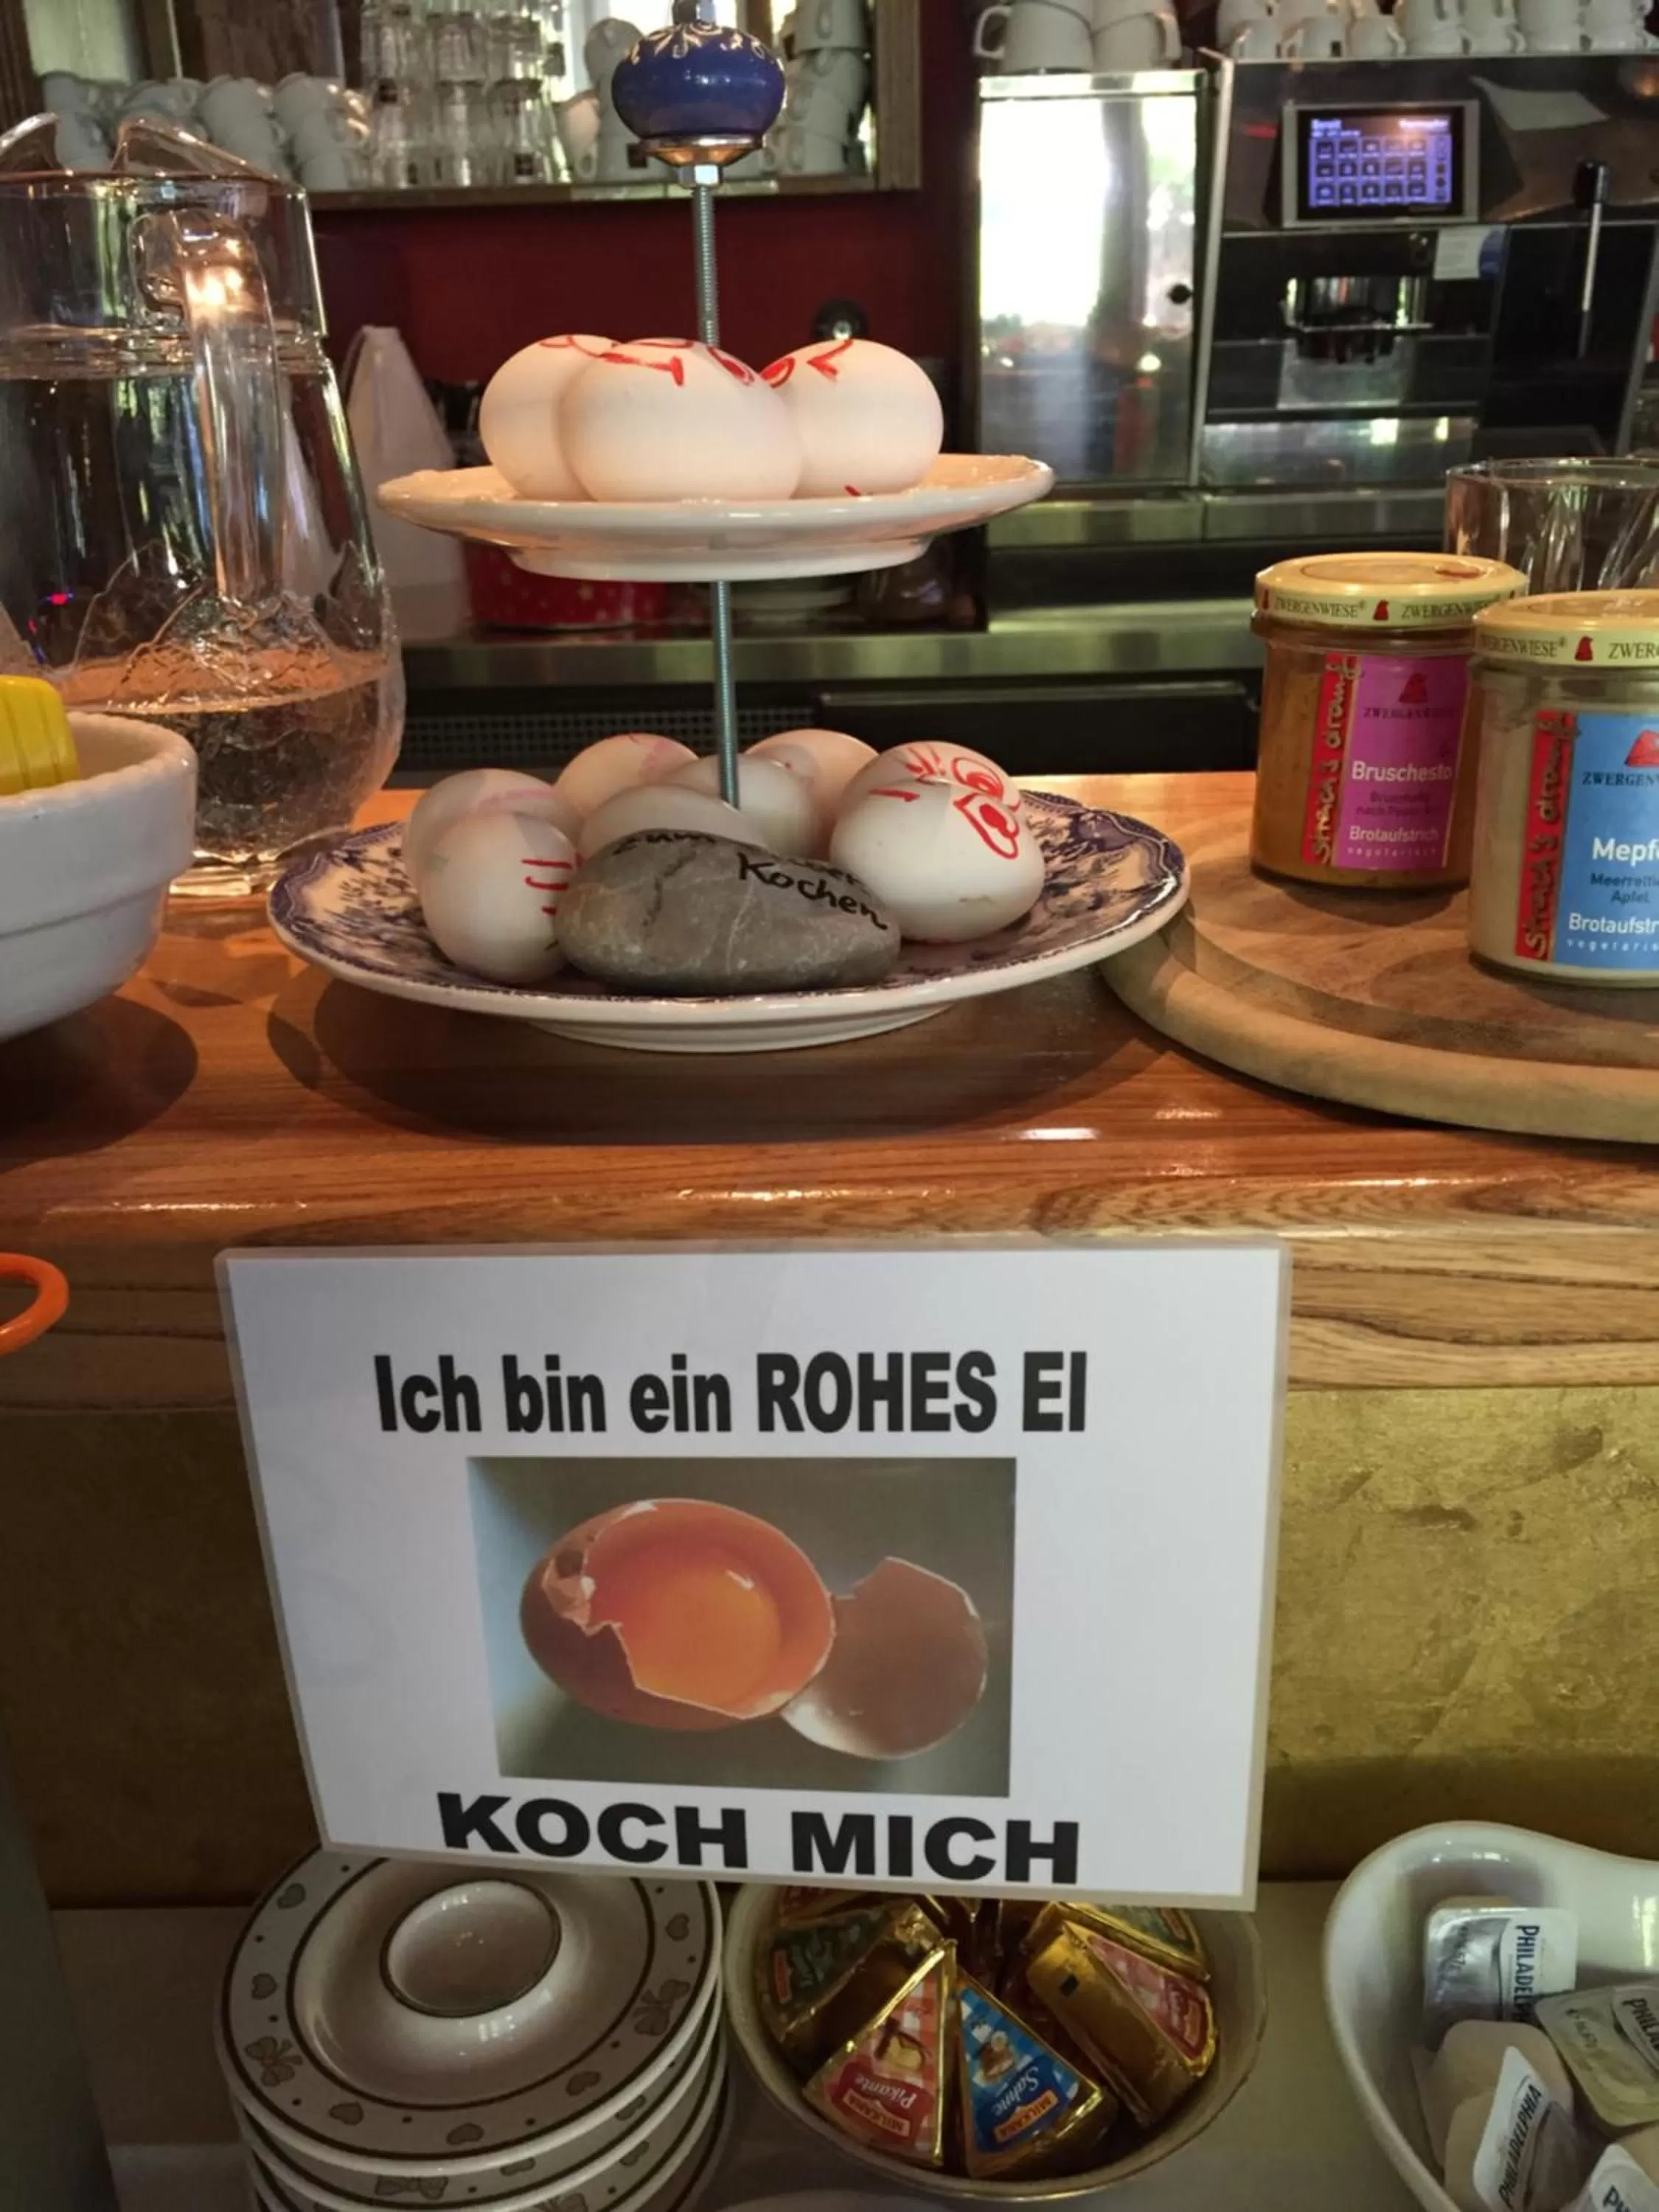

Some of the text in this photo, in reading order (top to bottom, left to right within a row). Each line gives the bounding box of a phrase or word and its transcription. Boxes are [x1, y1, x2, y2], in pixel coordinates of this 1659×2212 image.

[737, 851, 888, 931] Kochen
[374, 1351, 1087, 1433] Ich bin ein ROHES EI
[437, 1792, 1079, 1885] KOCH MICH
[855, 2073, 917, 2110] Pikante
[992, 2065, 1039, 2115] Sahne
[1498, 2083, 1543, 2208] PHILADELPHIA
